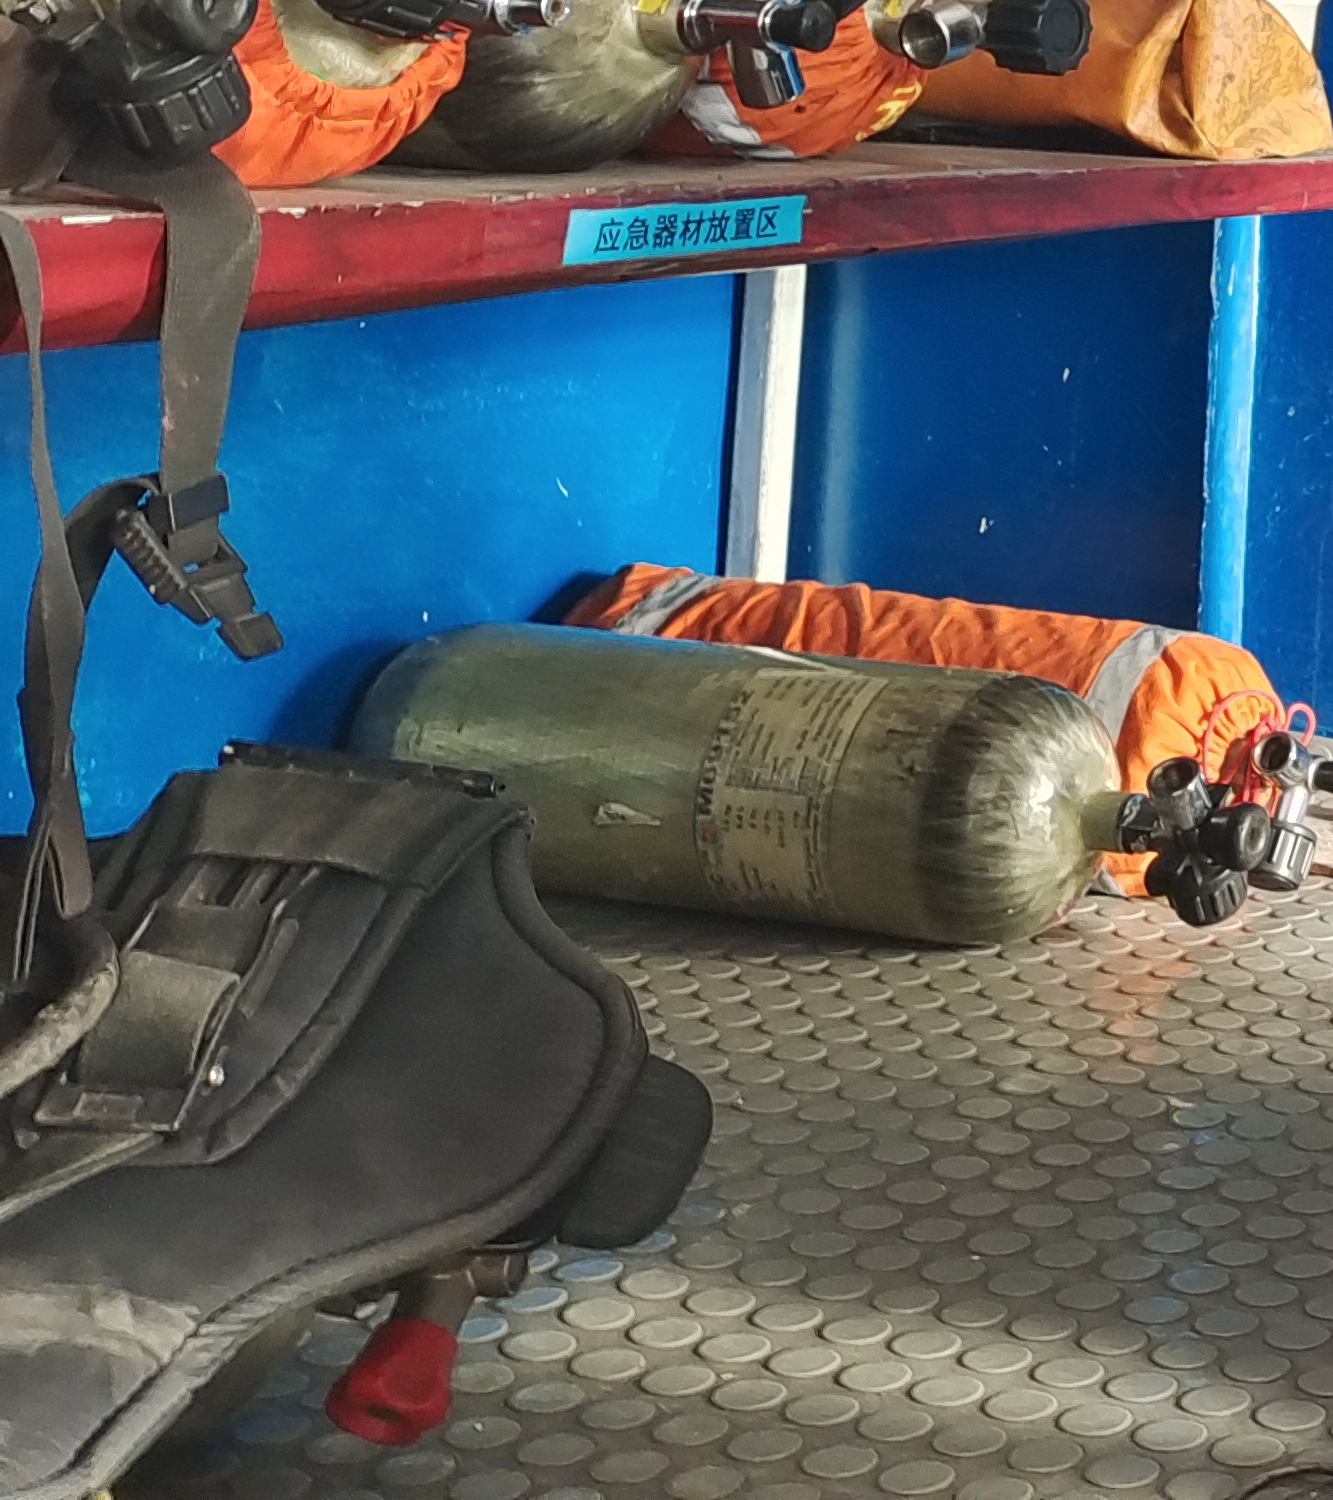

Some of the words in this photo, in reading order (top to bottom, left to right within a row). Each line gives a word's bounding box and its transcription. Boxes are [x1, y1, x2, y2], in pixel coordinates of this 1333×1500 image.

[594, 204, 781, 255] 应急器材放置区
